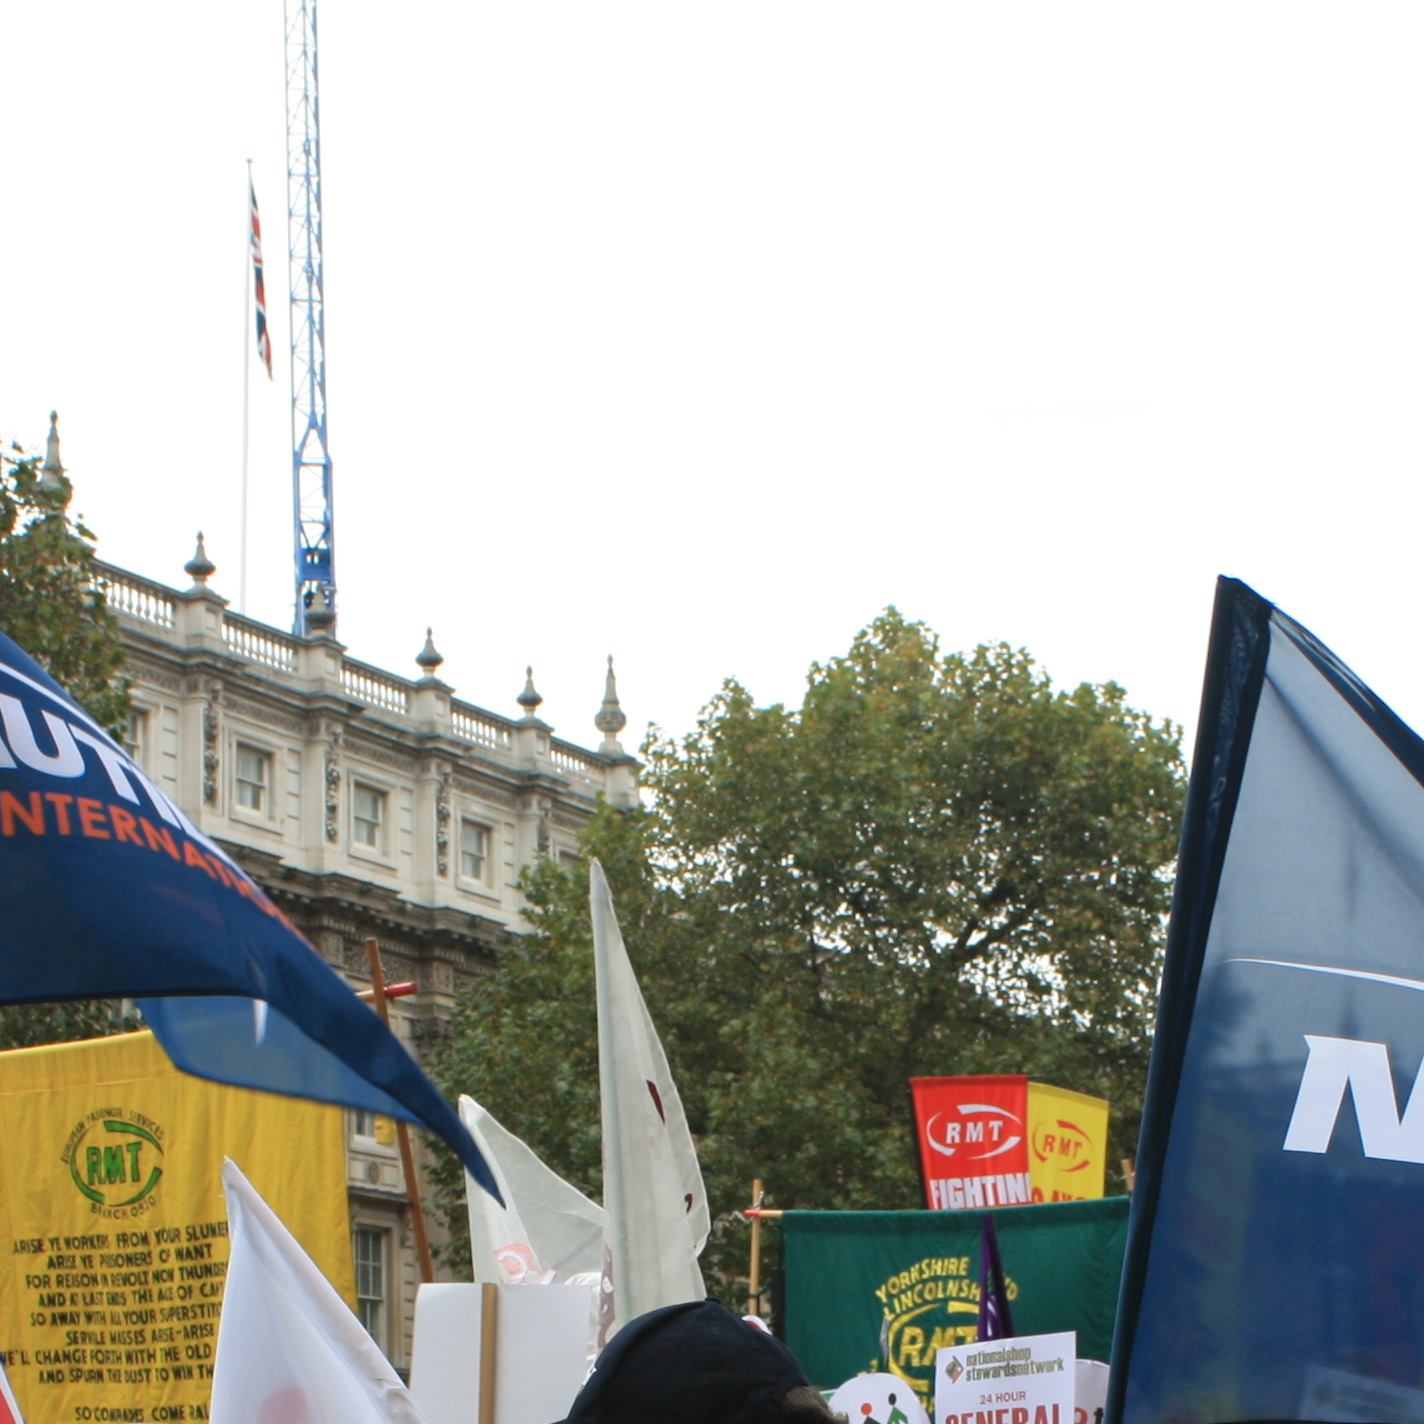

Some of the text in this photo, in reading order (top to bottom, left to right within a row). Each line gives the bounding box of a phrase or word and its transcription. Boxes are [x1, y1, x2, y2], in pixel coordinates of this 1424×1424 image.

[945, 1120, 1004, 1145] RMT
[1042, 1134, 1083, 1159] RMT
[86, 1141, 143, 1186] RMT
[13, 1238, 45, 1254] ARISE
[47, 1236, 62, 1251] YE
[116, 1231, 152, 1249] FROM
[153, 1226, 181, 1245] YOUR
[47, 1254, 77, 1270] ARISE
[80, 1254, 94, 1269] YE
[175, 1243, 213, 1262] WANT
[27, 1273, 51, 1289] FOR
[875, 1257, 970, 1303] YORKSHIRE
[38, 1292, 66, 1308] AND
[132, 1288, 153, 1304] THE
[177, 1284, 194, 1300] OF
[30, 1312, 47, 1327] SO
[50, 1311, 82, 1327] AWAY
[84, 1311, 107, 1326] WITH
[124, 1309, 157, 1326] YOUR
[35, 1348, 88, 1365] CHANGE
[125, 1349, 157, 1365] WITH
[160, 1345, 180, 1363] THE
[185, 1343, 211, 1360] OLD
[38, 1368, 65, 1384] AND
[107, 1367, 122, 1383] THE
[154, 1366, 169, 1382] TO
[171, 1365, 194, 1381] WIN
[979, 1391, 1027, 1405] 24 HOUR
[75, 1406, 92, 1421] SO
[151, 1405, 185, 1421] COME
